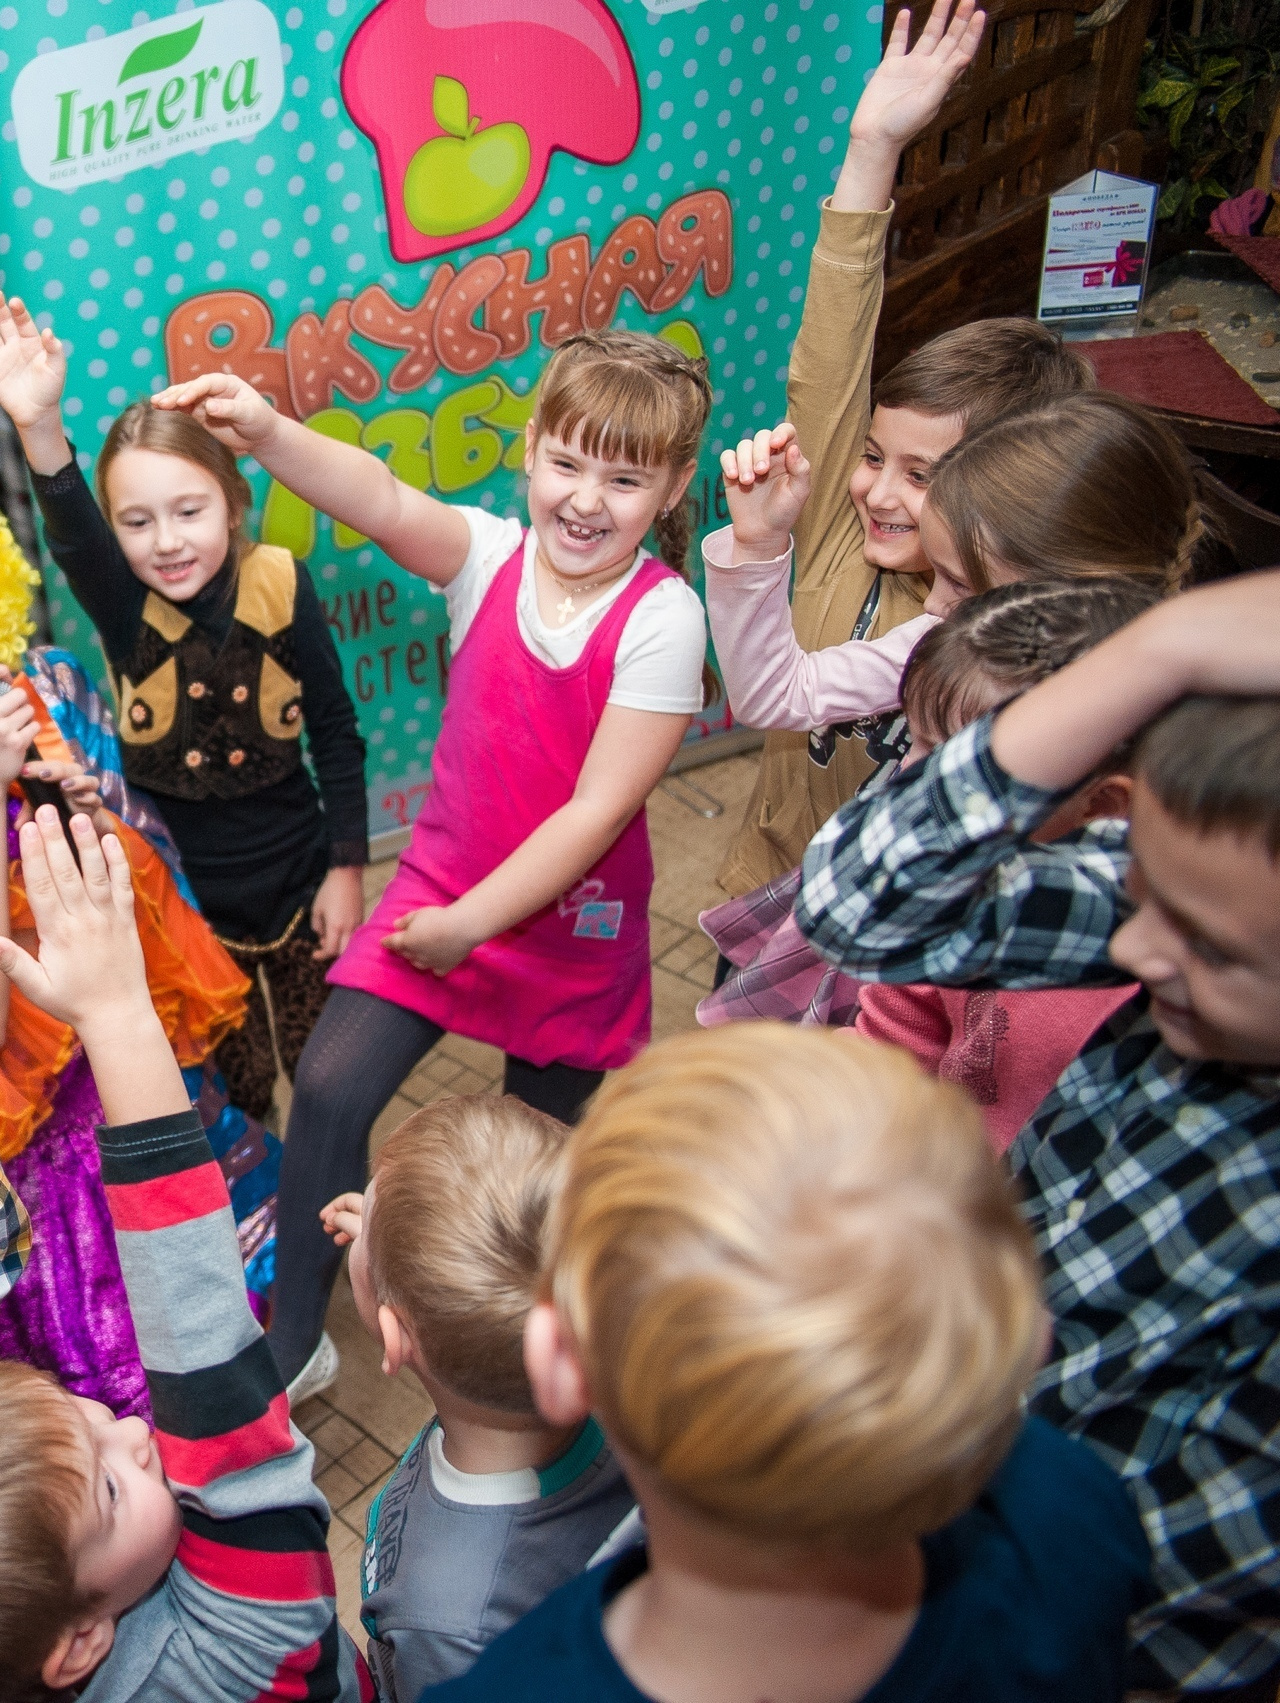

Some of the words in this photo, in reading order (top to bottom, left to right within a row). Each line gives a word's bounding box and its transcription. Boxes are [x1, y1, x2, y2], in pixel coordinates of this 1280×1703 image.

[48, 167, 78, 181] HIGH
[83, 152, 131, 174] QUALITY
[135, 140, 162, 157] PURE
[166, 124, 219, 146] DRINKING
[224, 112, 262, 129] WATER
[50, 56, 262, 166] Inzera
